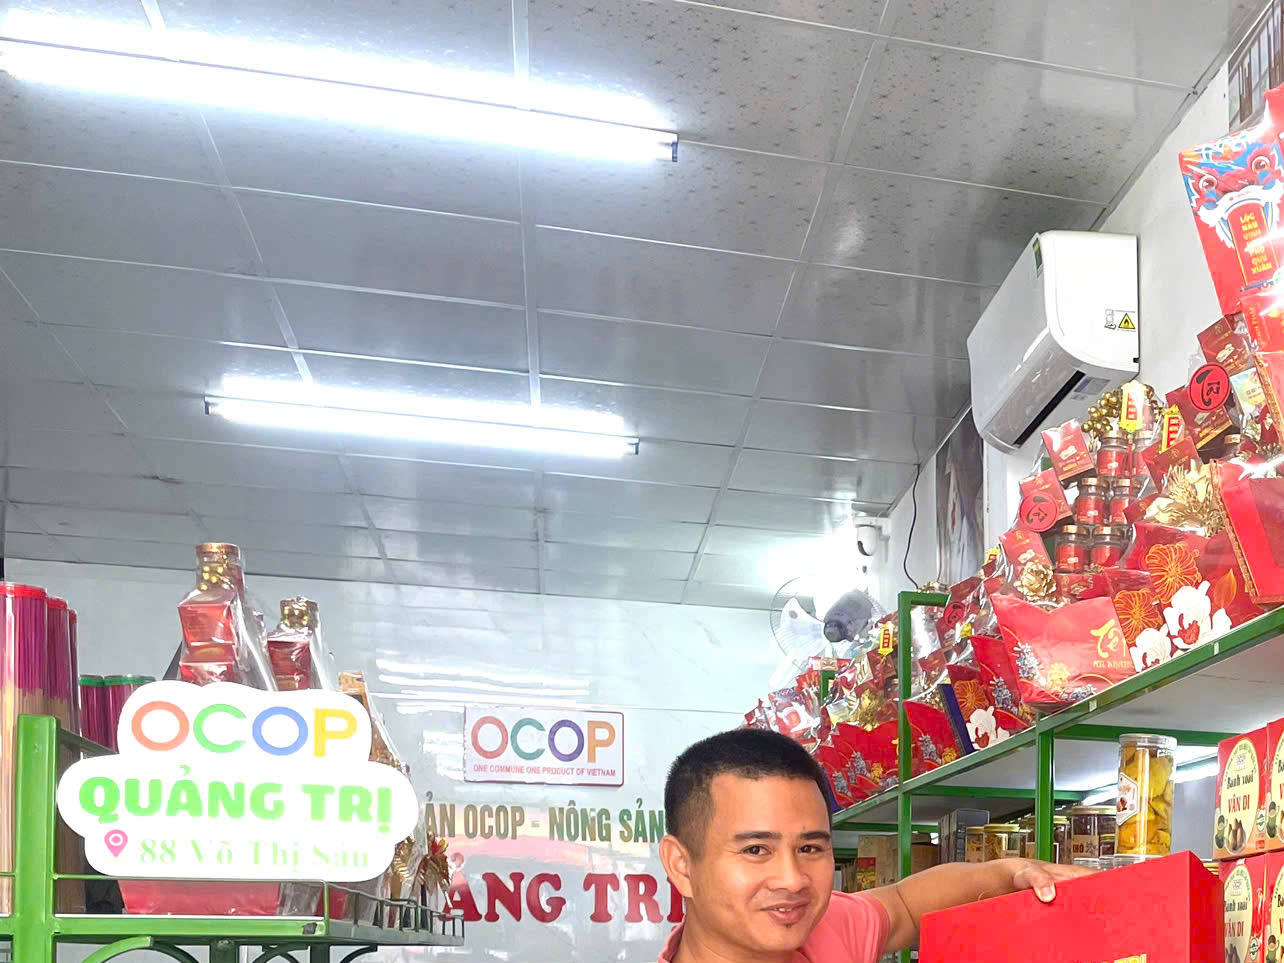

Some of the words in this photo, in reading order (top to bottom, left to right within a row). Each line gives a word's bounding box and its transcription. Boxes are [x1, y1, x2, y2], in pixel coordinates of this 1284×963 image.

[131, 700, 358, 758] OCOP
[471, 716, 616, 763] OCOP
[473, 764, 489, 773] ONE
[490, 764, 525, 774] COMMUNE
[526, 766, 541, 775] ONE
[542, 767, 574, 776] PRODUCT
[576, 768, 585, 776] OF
[586, 768, 616, 777] VIETNAM
[79, 764, 285, 824] QUẢNG
[301, 784, 392, 834] TRỊ
[424, 791, 456, 838] ẢN
[464, 805, 525, 840] OCOP
[550, 800, 611, 842] NÔNG
[619, 798, 665, 843] SẢN
[139, 837, 177, 865] 88
[187, 836, 233, 866] Võ
[251, 841, 300, 873] Thị
[440, 852, 566, 924] ẢNG
